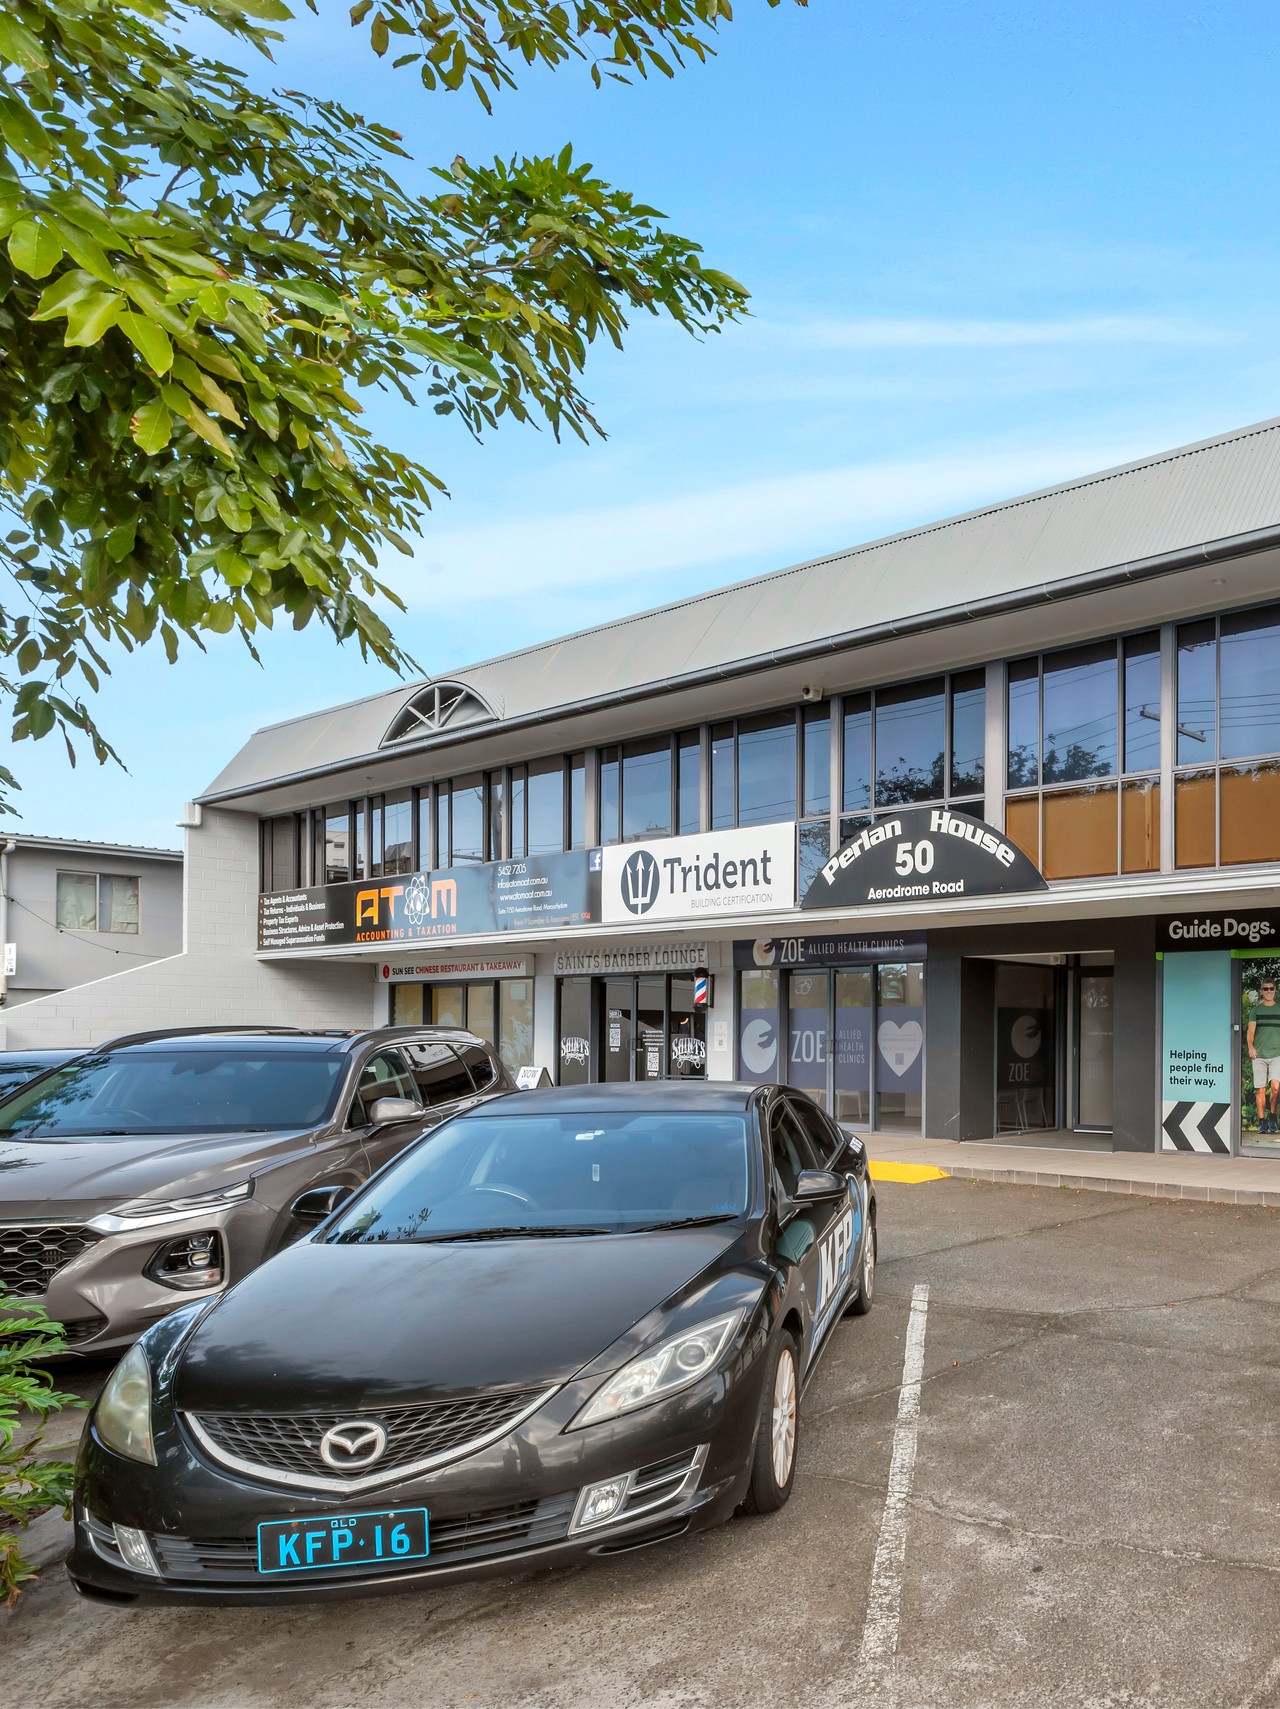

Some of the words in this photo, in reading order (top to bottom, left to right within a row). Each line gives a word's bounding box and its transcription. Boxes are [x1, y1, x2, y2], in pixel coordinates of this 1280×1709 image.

[821, 819, 902, 886] Perlan
[929, 810, 1016, 868] House
[895, 839, 935, 876] 50
[663, 849, 772, 894] Trident
[867, 884, 930, 900] Aerodrome
[932, 879, 964, 894] Road
[691, 897, 721, 908] BUILDING
[723, 893, 773, 906] CERTIFICATION
[356, 929, 405, 942] ACCOUNTING
[408, 928, 413, 937] &
[417, 924, 457, 936] TAXATION
[1169, 919, 1221, 939] Guide
[558, 955, 600, 970] SAINTS
[604, 952, 650, 968] BARBER
[655, 949, 705, 965] LOUNGE
[780, 939, 805, 963] ZOE
[808, 942, 835, 955] ALLIED
[838, 941, 868, 954] HEALTH
[871, 939, 905, 952] CLINICS
[392, 967, 403, 976] SUN
[404, 966, 414, 975] SEE
[415, 965, 440, 974] CHINESE
[440, 963, 479, 973] RESTAURANT
[480, 963, 485, 971] &
[486, 961, 522, 971] TAKEAWAY
[839, 1030, 861, 1040] ALLIED
[561, 1037, 590, 1057] SAINTS
[672, 1037, 706, 1060] SAINTS
[791, 1030, 826, 1063] ZOE
[839, 1042, 864, 1052] HEALTH
[1170, 1050, 1207, 1062] Helping
[839, 1054, 865, 1064] CLINICS
[1170, 1063, 1202, 1074] people
[1205, 1063, 1224, 1073] find
[1008, 1063, 1030, 1082] ZOE
[1169, 1075, 1192, 1085] their
[1194, 1078, 1216, 1088] way.
[820, 1209, 852, 1312] KFP
[330, 1518, 357, 1528] QLD
